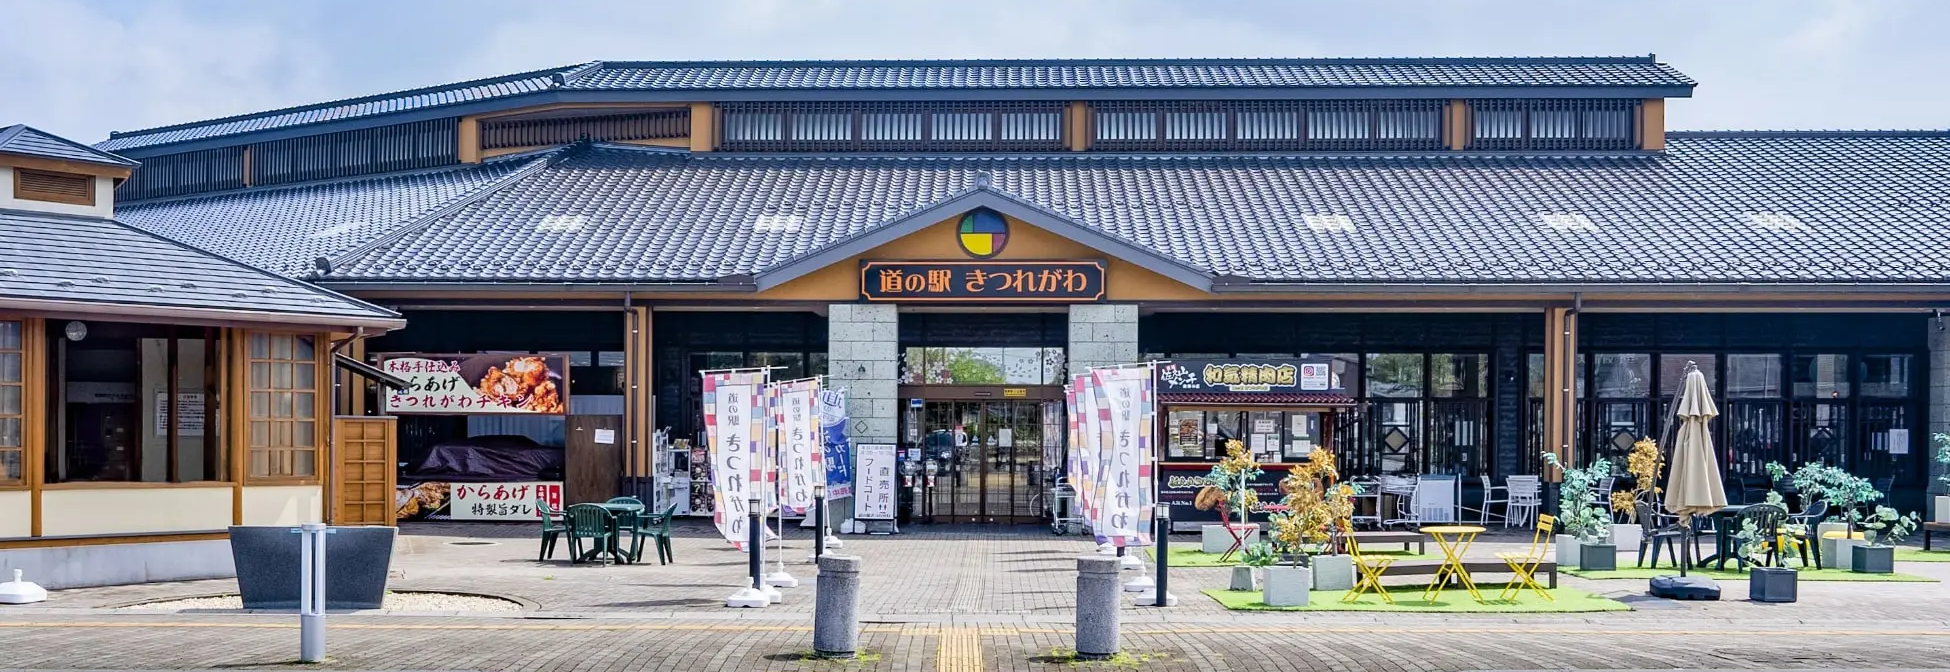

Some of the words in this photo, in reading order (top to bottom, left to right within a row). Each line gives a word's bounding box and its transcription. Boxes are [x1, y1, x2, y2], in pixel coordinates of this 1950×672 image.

[879, 269, 952, 293] 道の駅
[965, 268, 1088, 293] きつれがわ
[388, 360, 461, 373] 本格手仕込み
[408, 375, 461, 392] らあげ
[390, 394, 534, 409] きつれがわチキン
[456, 484, 531, 501] からあげ
[863, 458, 874, 512] フードコート
[878, 467, 890, 503] 直売所
[471, 503, 532, 516] 特製旨ダレ
